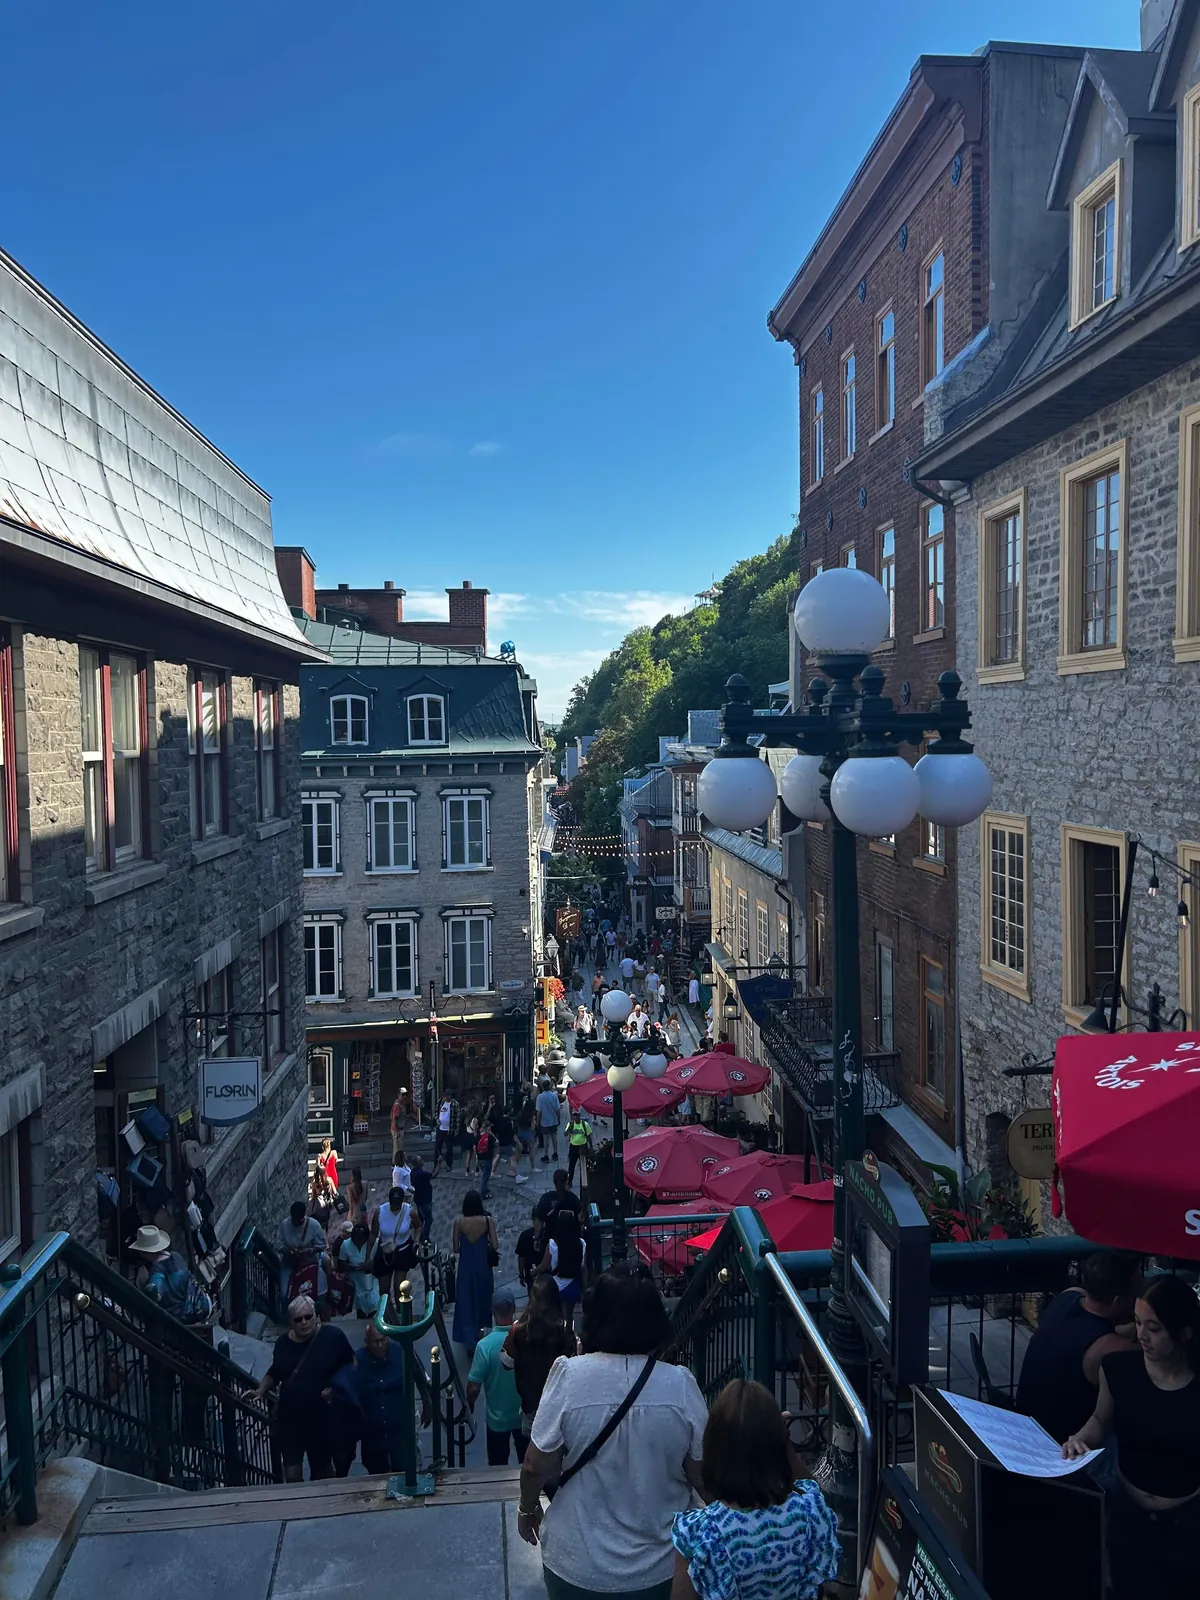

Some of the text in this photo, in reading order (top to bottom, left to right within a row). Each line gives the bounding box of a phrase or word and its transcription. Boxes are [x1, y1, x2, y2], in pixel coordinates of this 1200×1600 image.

[1094, 1055, 1145, 1089] ARTOIS
[206, 1084, 256, 1098] FLORIN
[849, 1164, 875, 1203] NACHO
[877, 1197, 893, 1226] PUB
[924, 1467, 968, 1529] NACHO PUB
[912, 1555, 925, 1580] LES
[916, 1541, 936, 1577] VENEZ
[907, 1569, 930, 1600] NA
